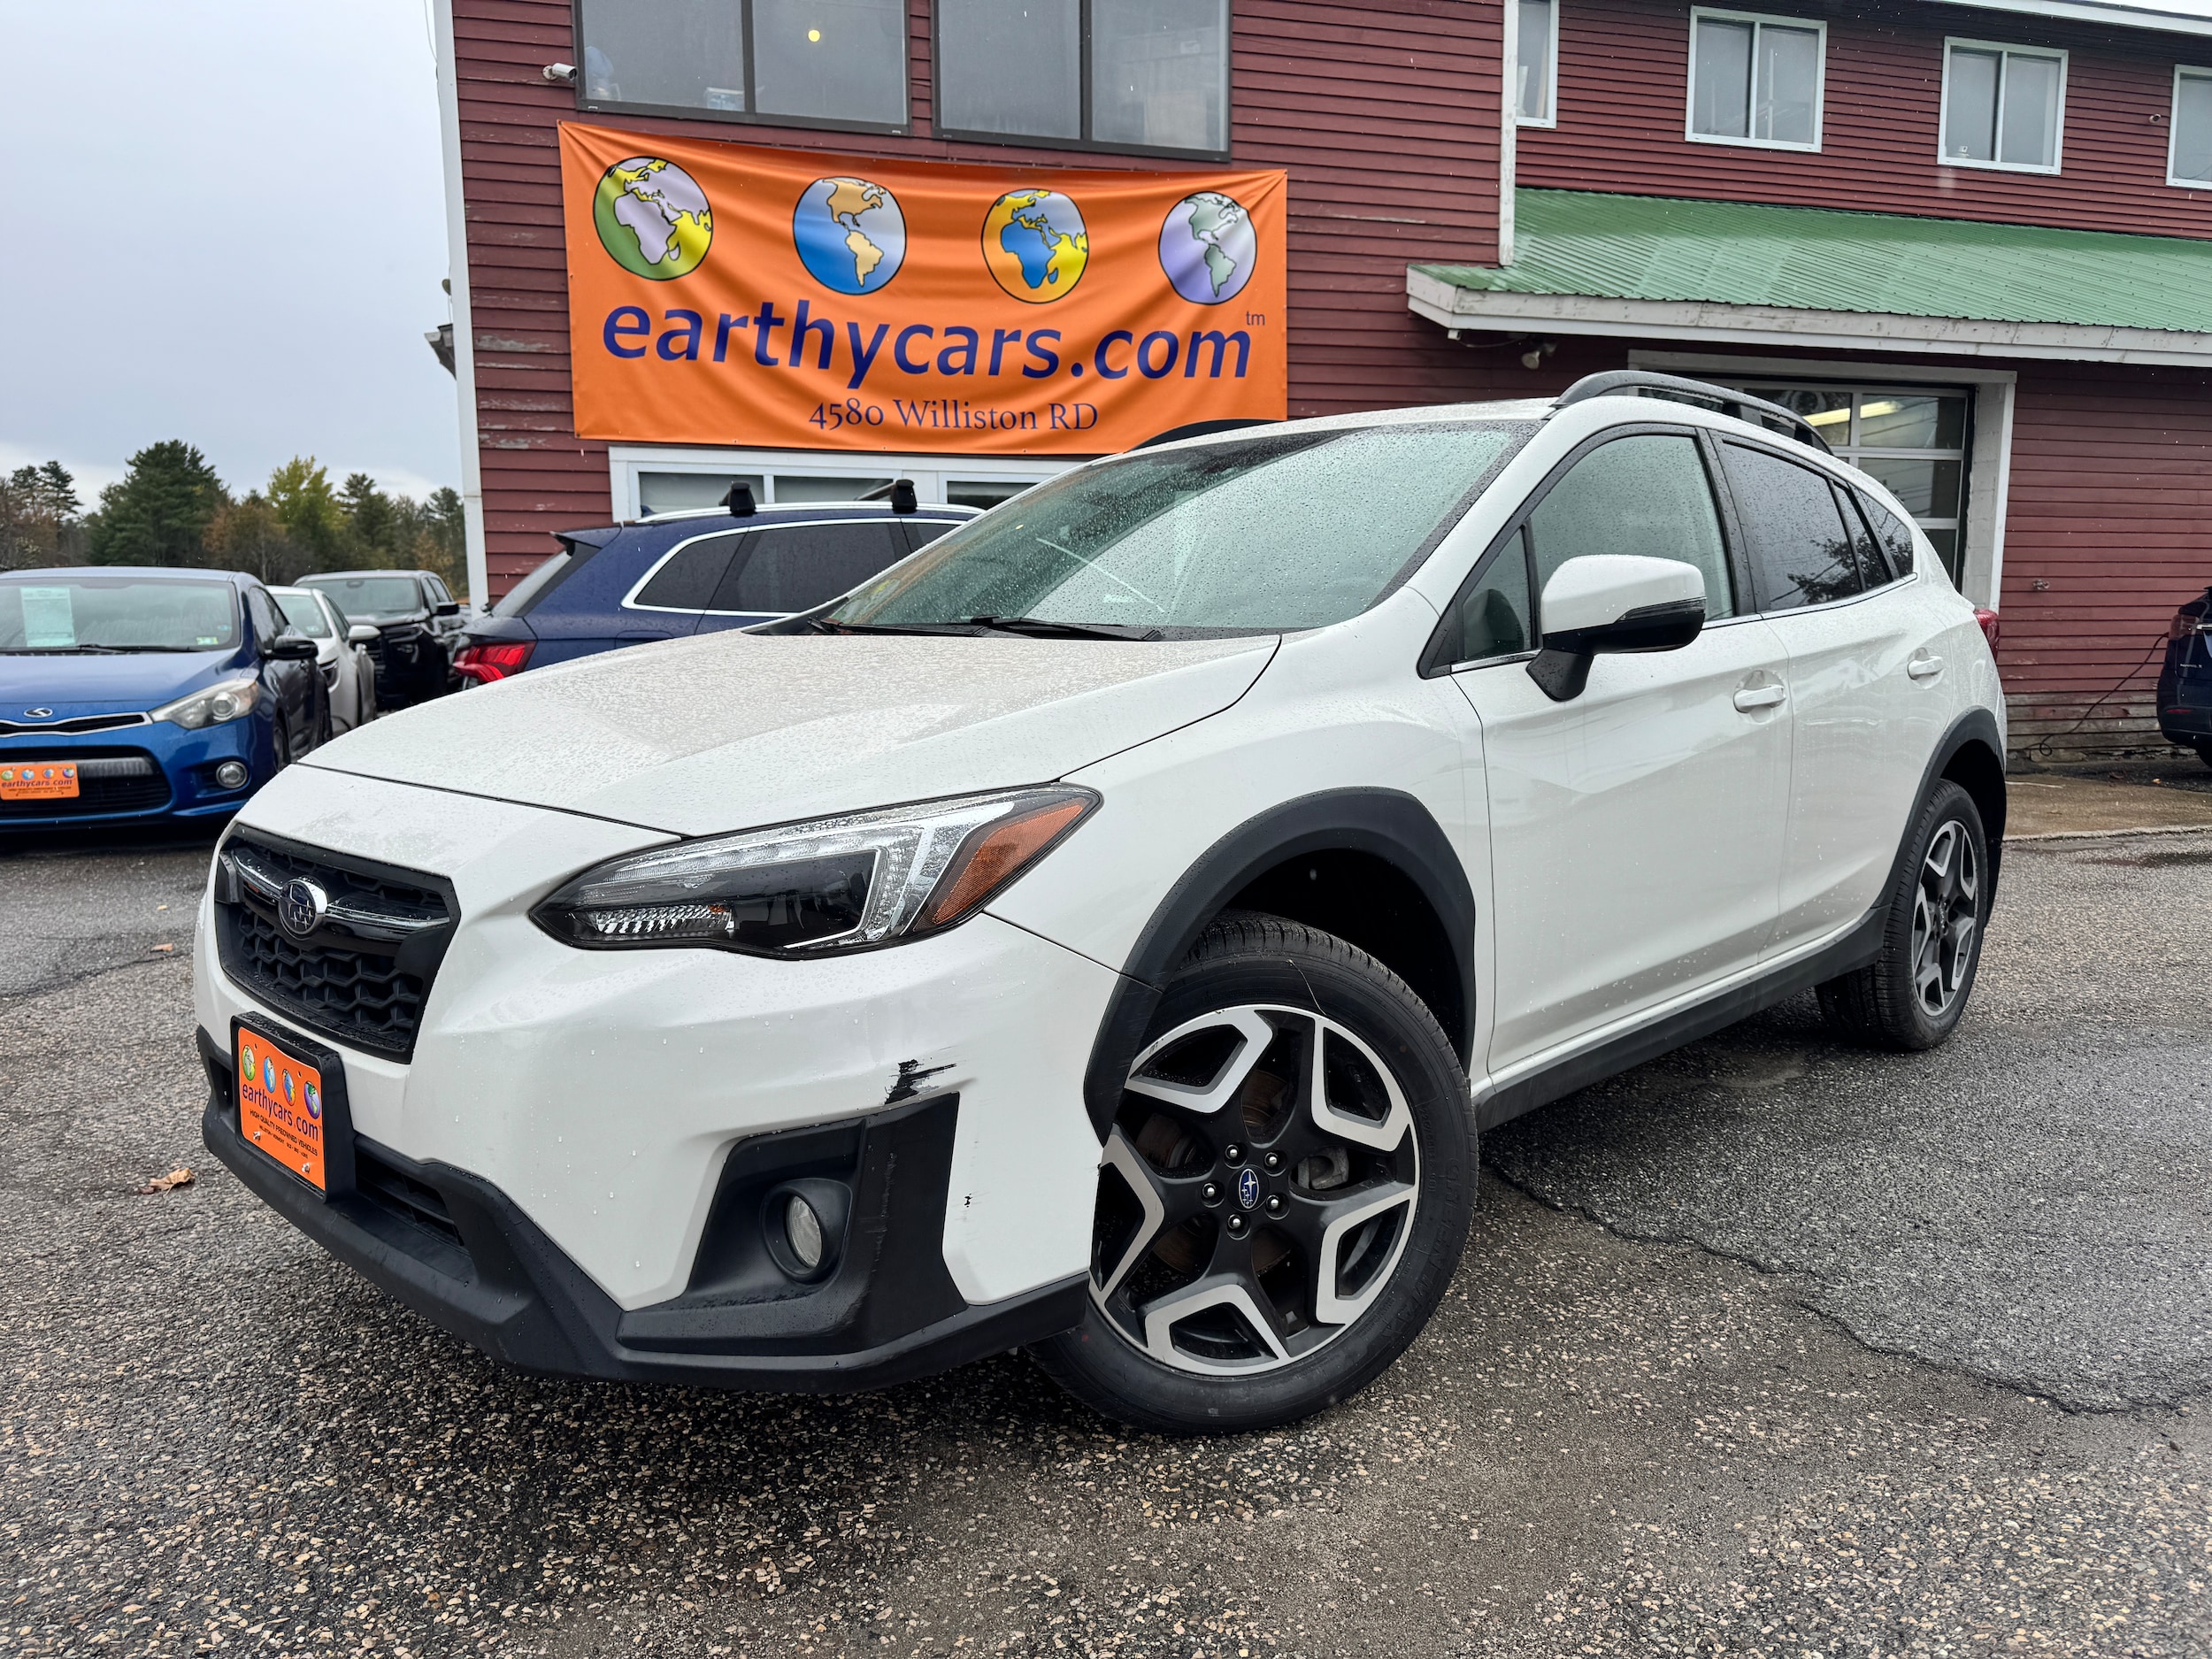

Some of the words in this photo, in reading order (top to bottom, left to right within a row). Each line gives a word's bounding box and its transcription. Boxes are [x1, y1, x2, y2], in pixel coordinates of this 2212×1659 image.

[603, 300, 1251, 389] earthycars.com
[1246, 311, 1265, 326] tm
[809, 397, 884, 431] 4580
[893, 398, 1038, 430] Williston
[1048, 403, 1098, 430] RD
[2, 780, 73, 788] earthycarscom
[242, 1084, 319, 1141] earthycars.com
